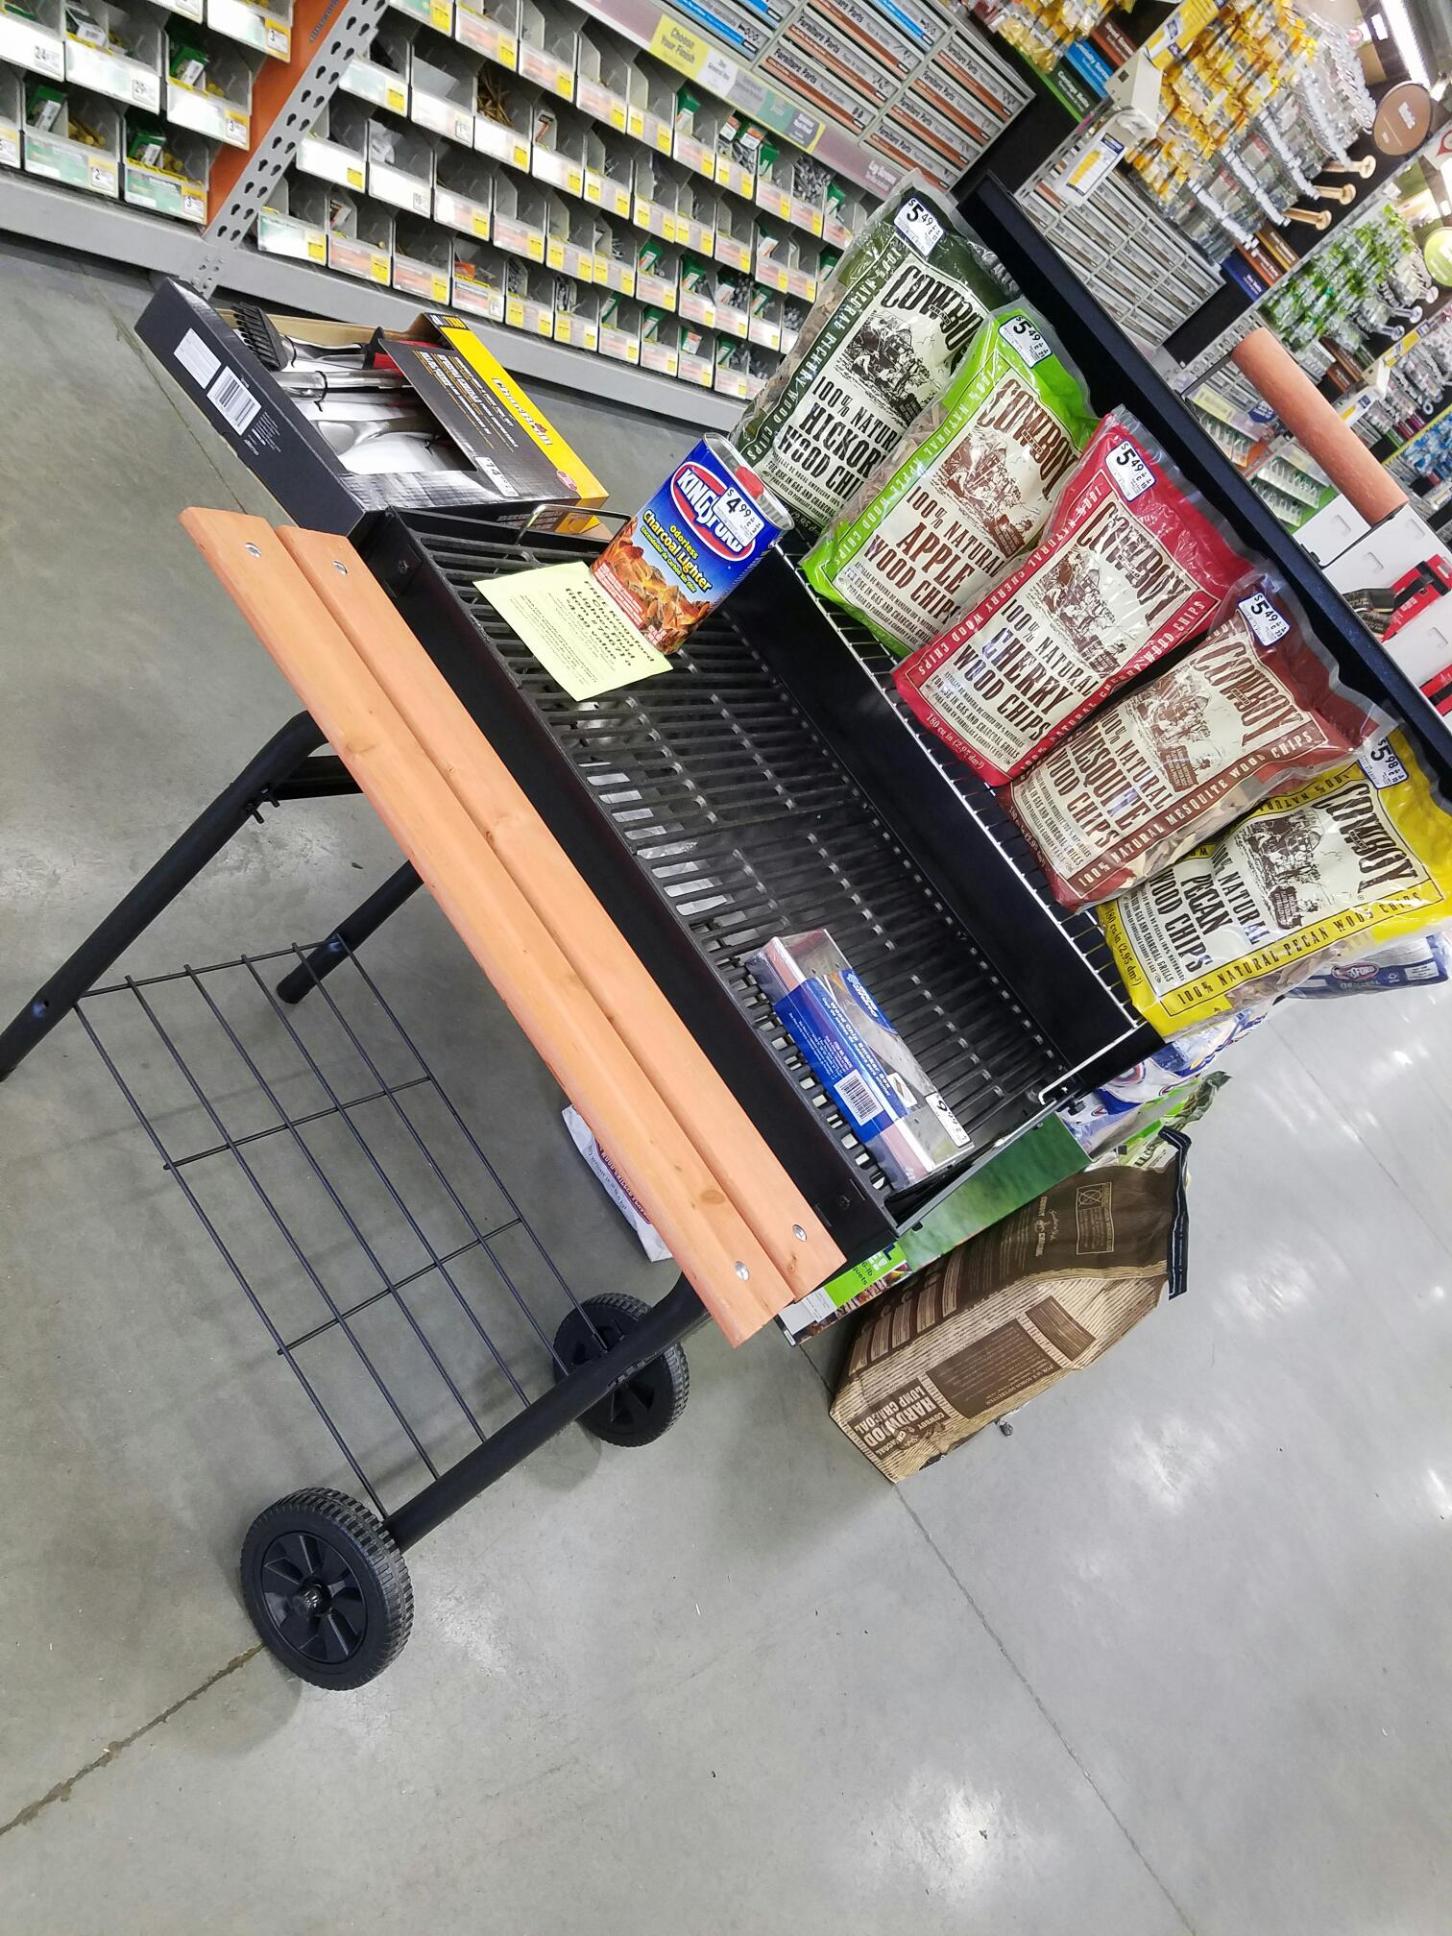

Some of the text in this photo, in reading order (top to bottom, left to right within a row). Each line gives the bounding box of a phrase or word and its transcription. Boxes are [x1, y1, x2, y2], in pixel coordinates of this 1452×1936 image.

[823, 36, 842, 54] Parts
[799, 66, 819, 85] Parts
[811, 375, 856, 418] 100%
[773, 424, 832, 481] WOOD
[797, 401, 887, 482] HICKOR
[977, 378, 1079, 500] COWBOY
[790, 480, 803, 492] GAS
[800, 488, 813, 500] AND
[640, 508, 713, 593] Charcoal Lighter
[667, 523, 699, 560] Odorless
[894, 521, 975, 595] APPLE
[905, 484, 1005, 578] 100% NATURAL
[861, 534, 918, 591] WOOD
[1077, 502, 1194, 625] COWBOY
[575, 589, 611, 630] Lighter
[609, 630, 637, 660] Fluid
[583, 579, 610, 611] FREE
[607, 609, 656, 663] Kingsford
[590, 597, 635, 648] Charcoal
[870, 591, 884, 606] GAS
[881, 600, 894, 614] AND
[890, 608, 918, 633] CHARCOAL
[949, 611, 984, 643] WOOD
[1172, 599, 1205, 631] CHIPS
[589, 629, 617, 660] value
[915, 639, 951, 679] CHIPS
[978, 625, 1073, 716] CHERRY
[1000, 597, 1100, 699] 100% NATURAL
[925, 713, 940, 728] 180
[931, 674, 944, 689] FOR
[949, 694, 960, 705] IN
[955, 701, 969, 716] GAS
[965, 711, 979, 726] AND
[975, 722, 1002, 746] CHARCOAL
[999, 740, 1020, 759] GRILLS
[951, 643, 1051, 743] WOOD CHIPS
[1190, 641, 1303, 747] COWBOY
[1064, 724, 1152, 831] MESQUITE
[1097, 708, 1174, 811] 100% NATURAL
[1033, 795, 1045, 807] GAS
[1039, 805, 1052, 818] AND
[1042, 748, 1120, 850] WOOD CHIPS
[1076, 861, 1111, 888] 100%
[1109, 820, 1165, 864] NATURAL
[1164, 777, 1230, 827] MESQUITE
[1269, 729, 1313, 762] CHIPS
[1045, 816, 1069, 846] CHARCOAL
[1313, 782, 1419, 894] COWBOY
[1134, 910, 1146, 922] GAS
[1138, 920, 1151, 933] AND
[1147, 868, 1213, 973] WOOD CHIPS
[1179, 871, 1233, 936] PECAN
[1217, 870, 1271, 945] NATURAL
[1142, 931, 1164, 961] CHARCOAL
[1156, 959, 1175, 982] GRILLS
[1177, 980, 1214, 1005] 100%
[1217, 948, 1280, 987] NATURAL
[1282, 925, 1329, 955] PECAN
[829, 1000, 847, 1023] Wood
[843, 1022, 859, 1042] Chip
[897, 1385, 925, 1408] LUMP
